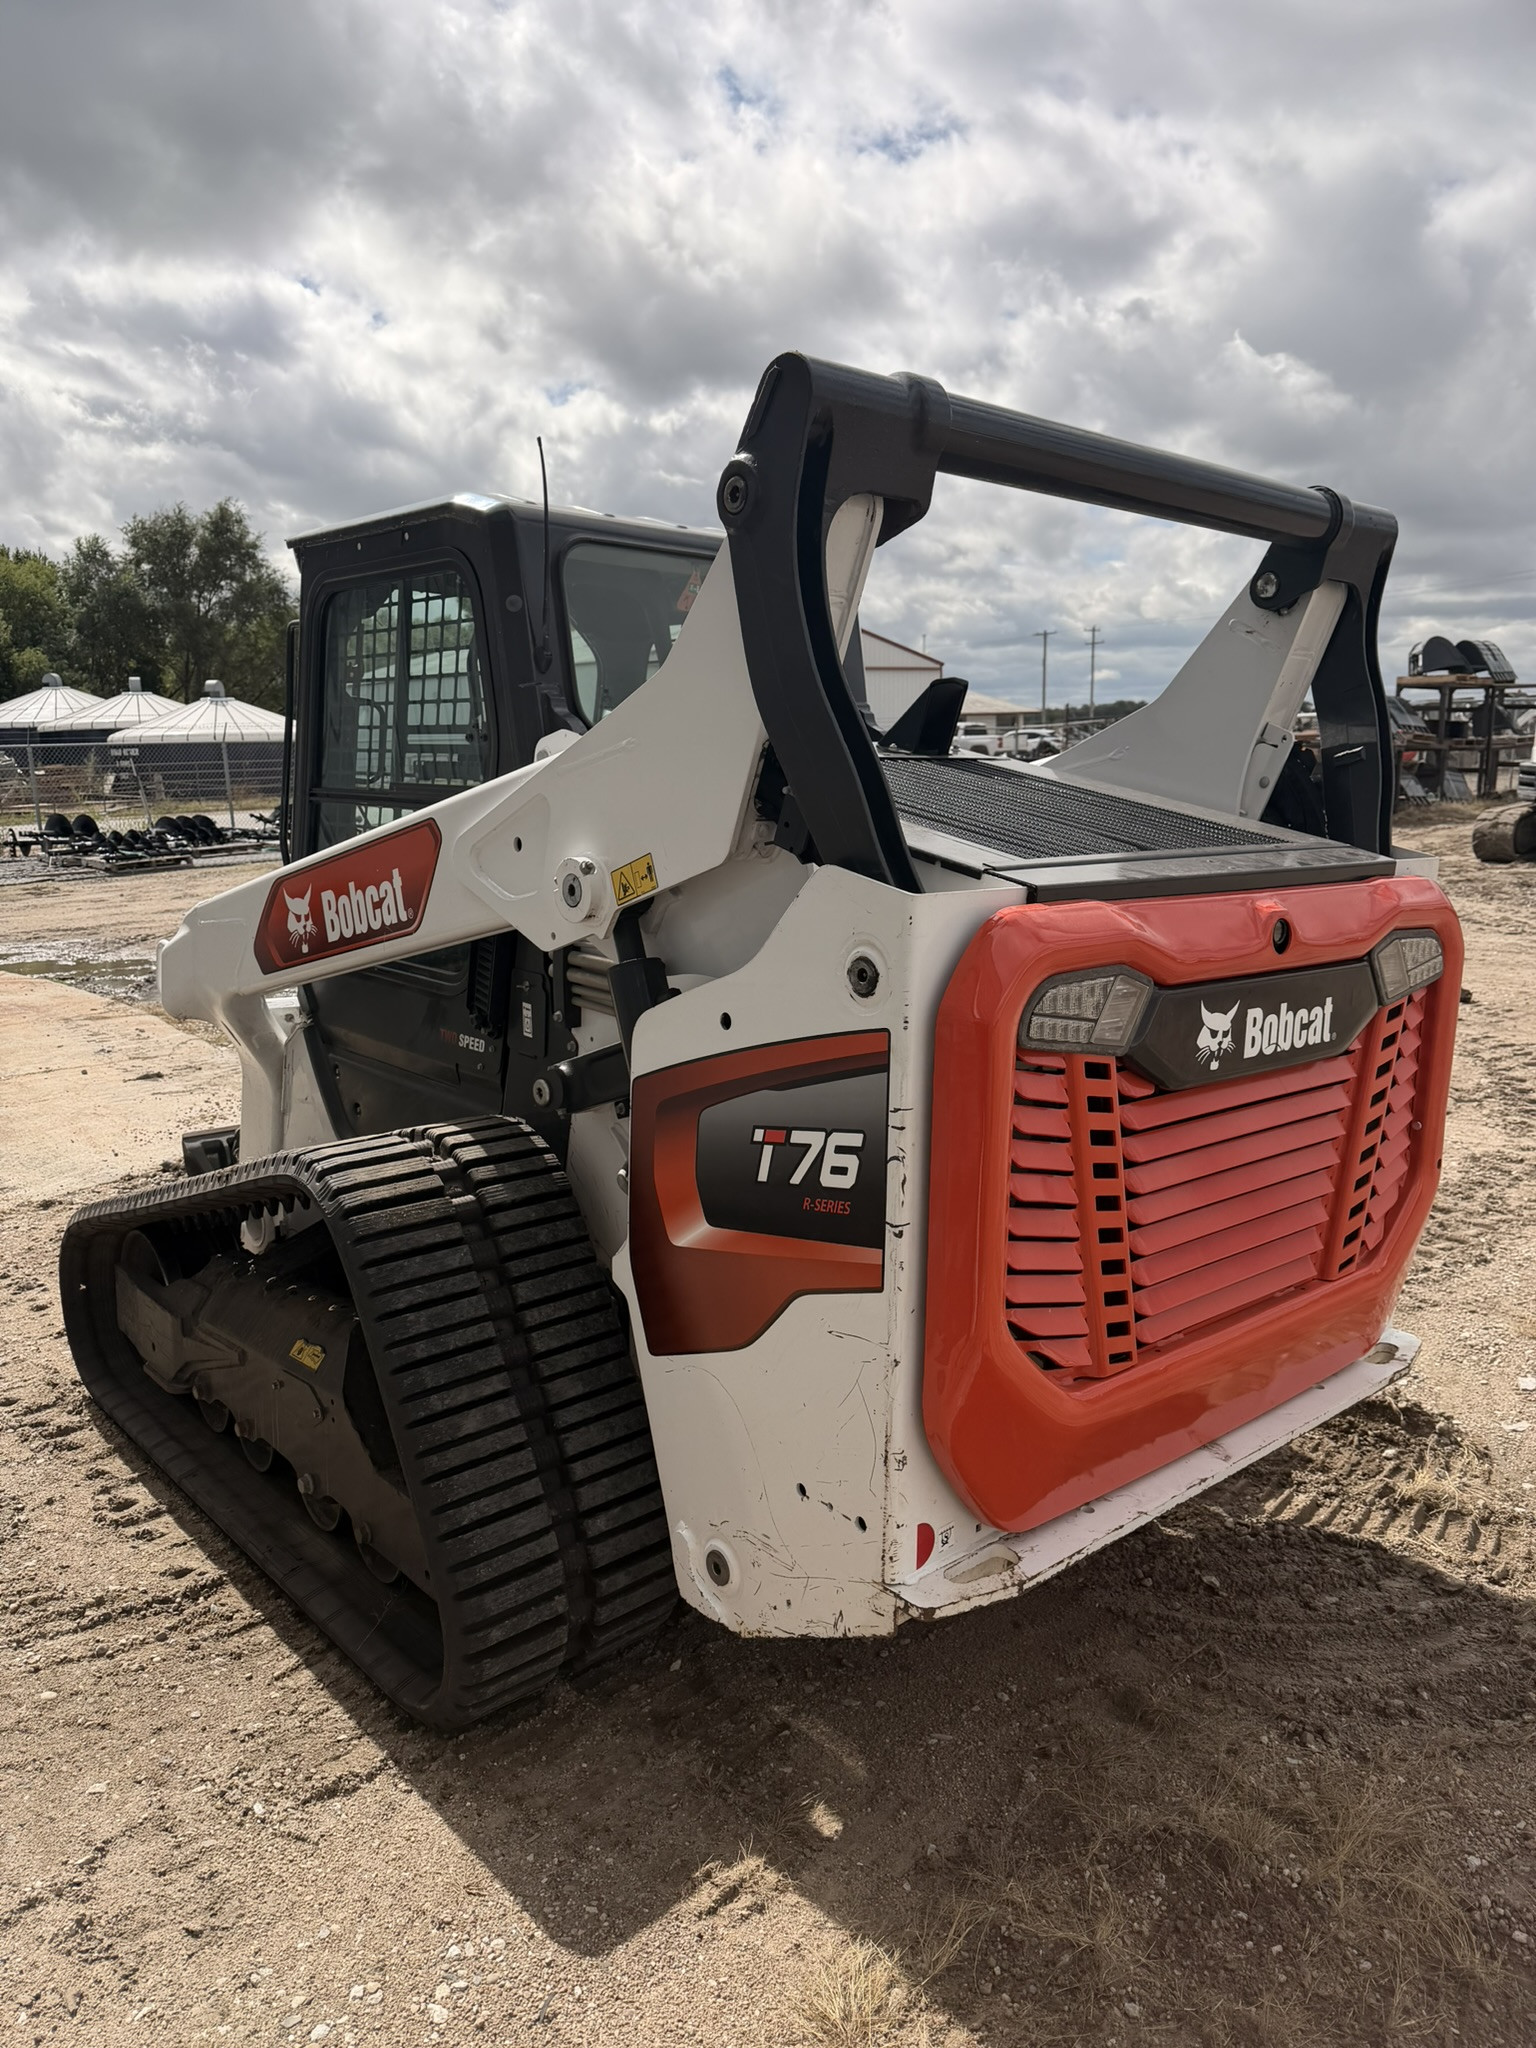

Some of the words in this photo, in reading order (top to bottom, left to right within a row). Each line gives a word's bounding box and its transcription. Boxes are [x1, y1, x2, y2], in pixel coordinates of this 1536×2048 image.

[320, 867, 408, 943] Bobcat
[458, 1033, 485, 1052] SPEED
[1243, 996, 1333, 1059] Bobcat
[752, 1128, 865, 1189] T76
[802, 1197, 851, 1215] R-SERIES
